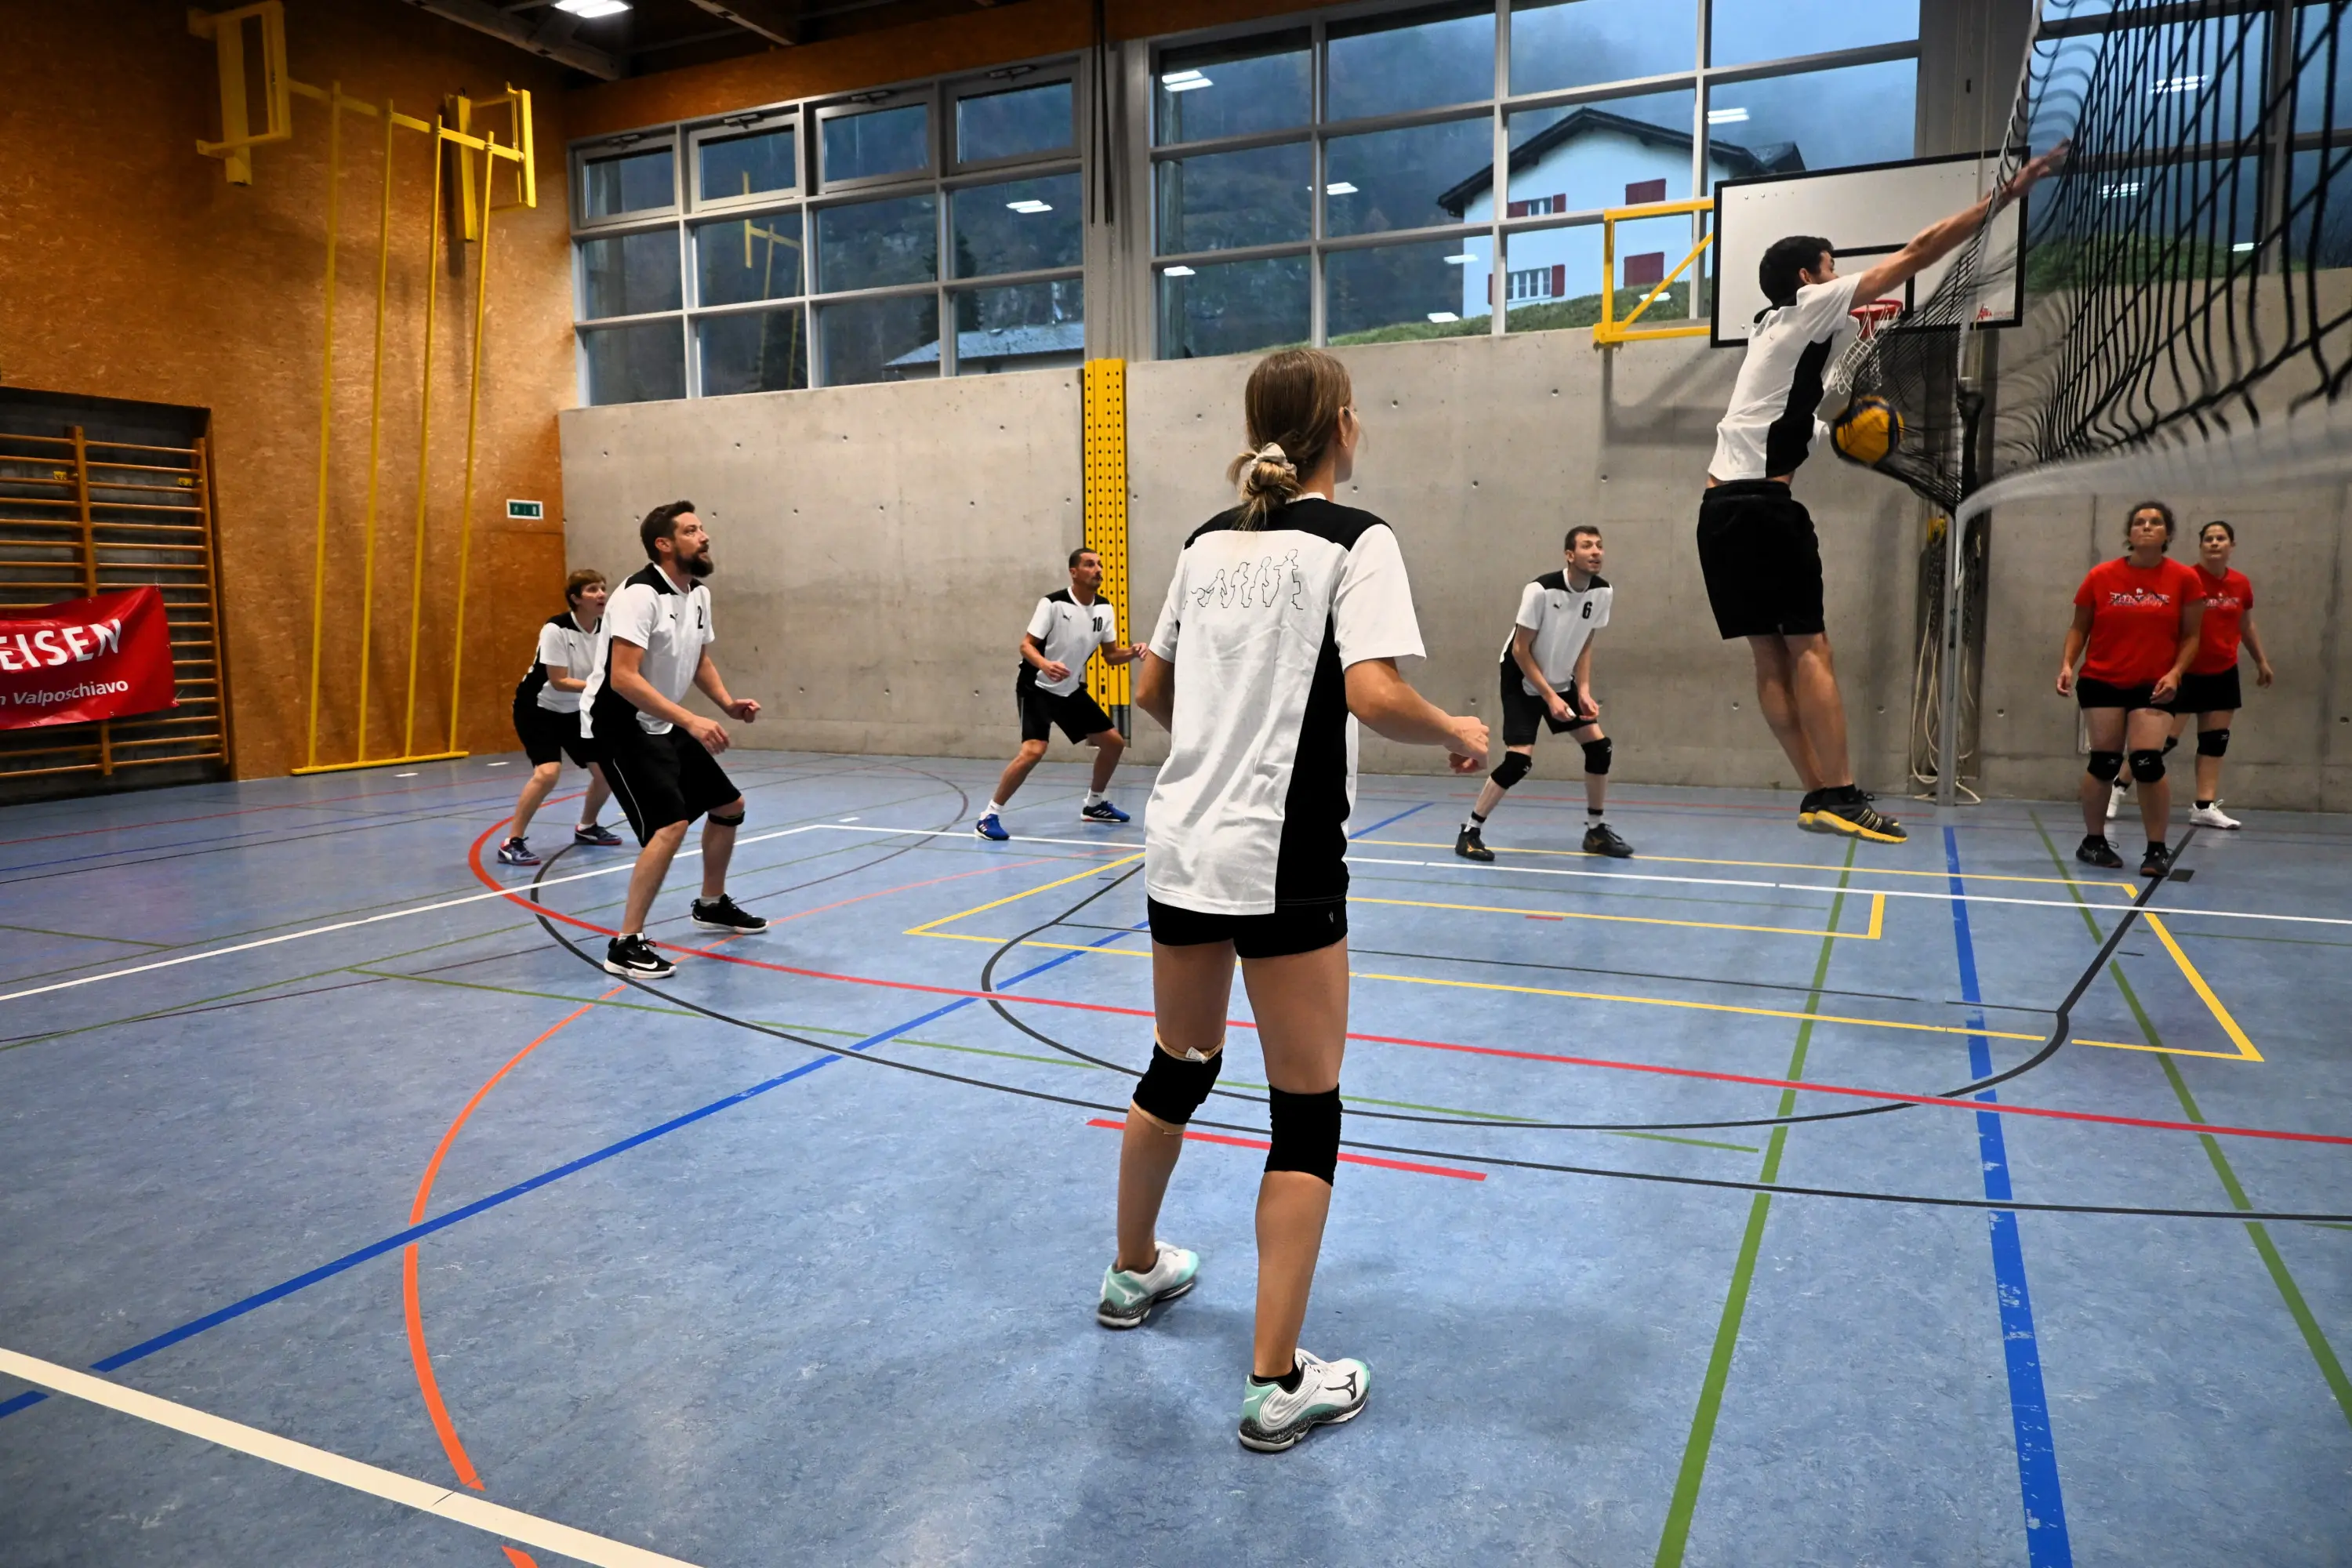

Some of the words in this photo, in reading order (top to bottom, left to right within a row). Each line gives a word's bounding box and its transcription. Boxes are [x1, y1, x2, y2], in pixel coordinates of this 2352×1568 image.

[697, 605, 703, 629] 2
[1582, 601, 1592, 619] 6
[1092, 616, 1102, 632] 10
[13, 681, 129, 706] Valposchiavo
